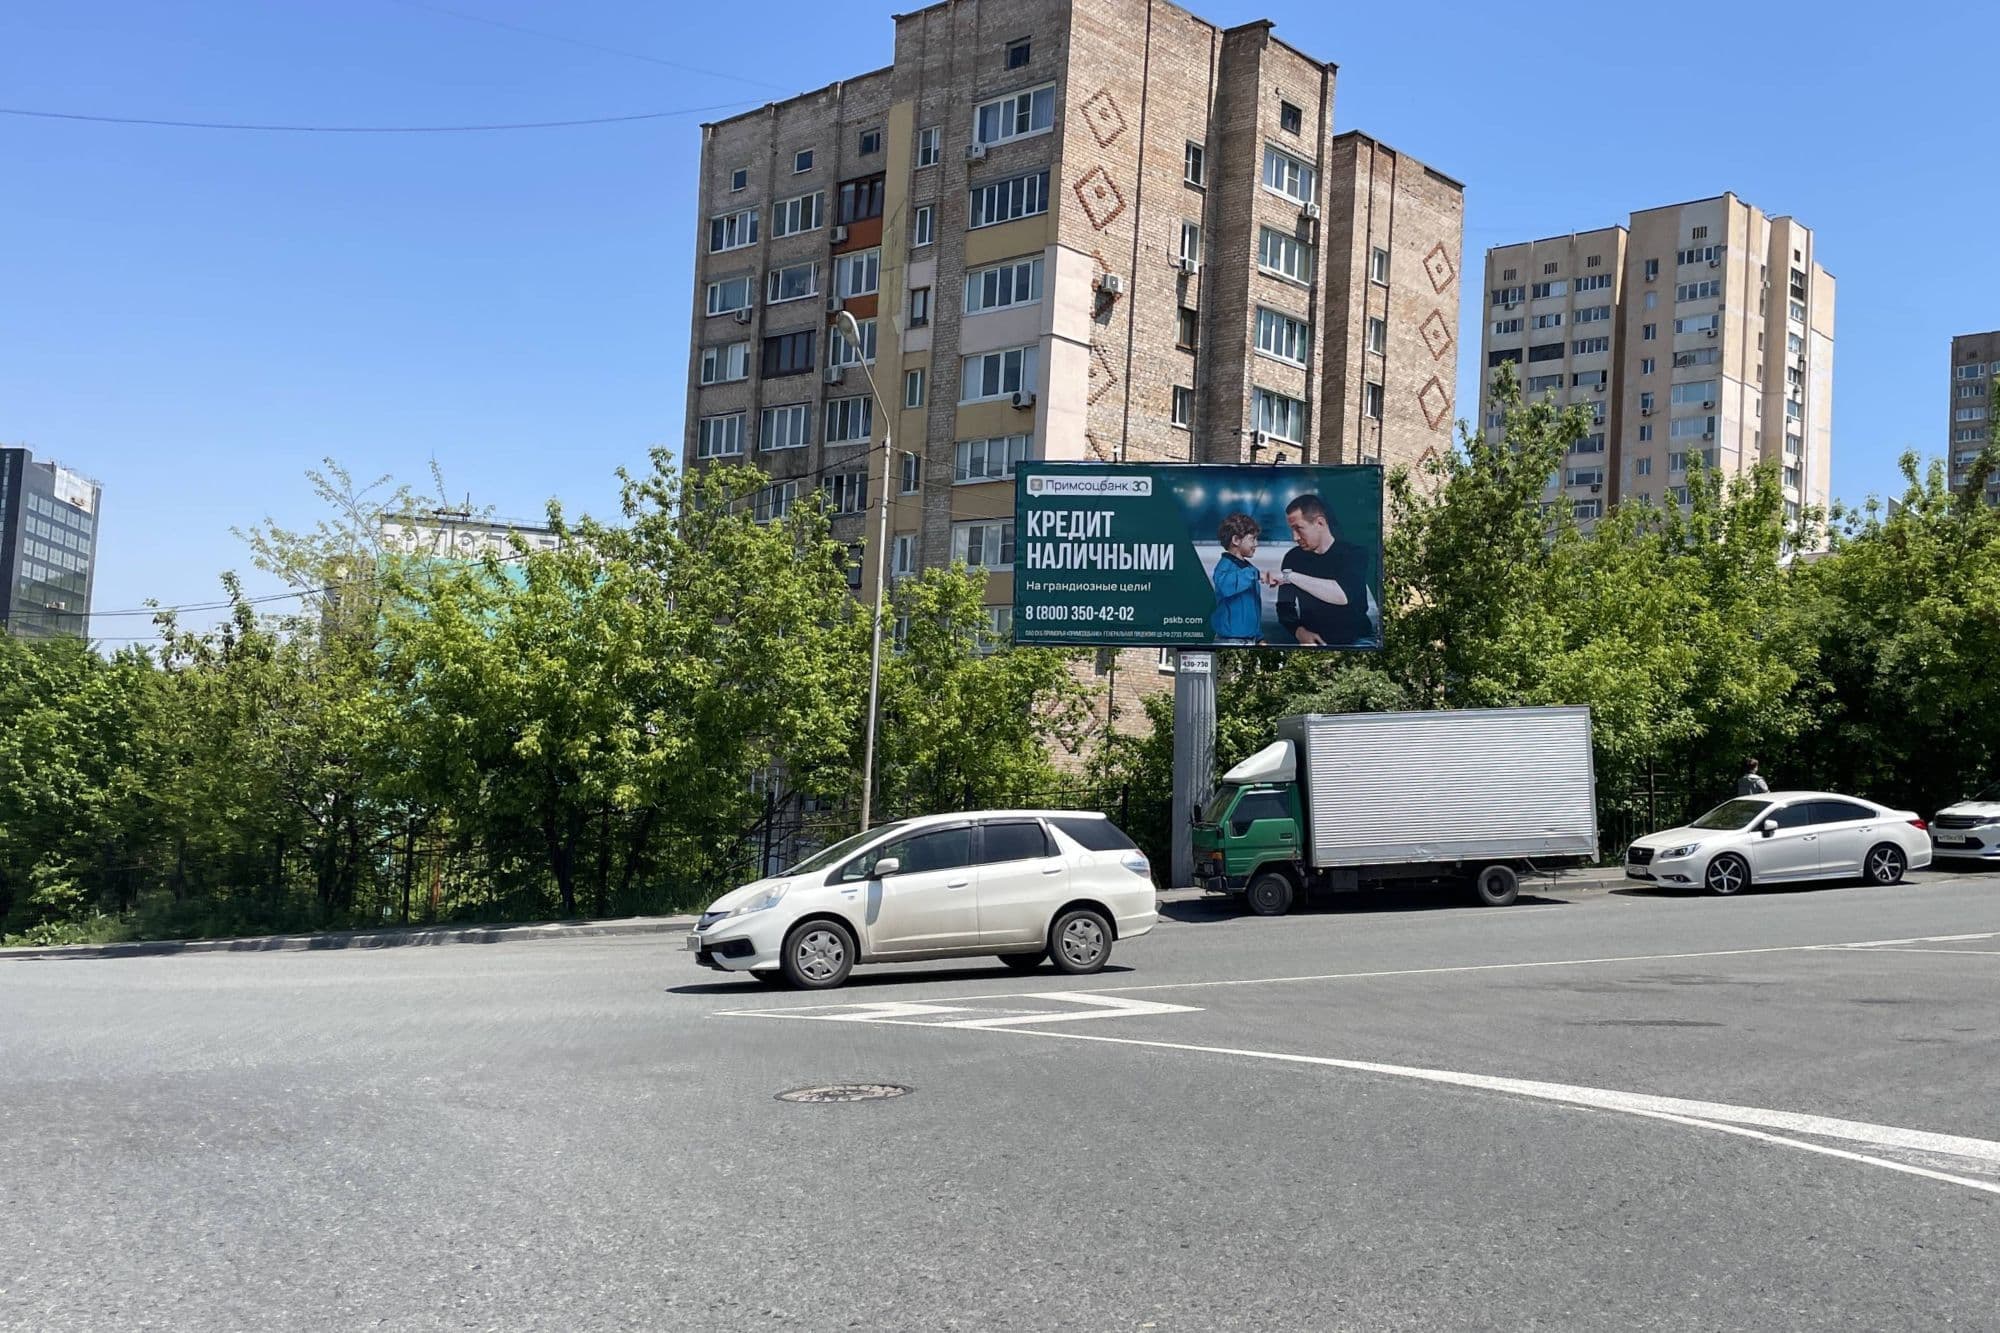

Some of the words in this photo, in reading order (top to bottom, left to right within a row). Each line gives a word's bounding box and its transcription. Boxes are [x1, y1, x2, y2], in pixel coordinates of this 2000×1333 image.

[1045, 479, 1128, 493] Примсоцбанк
[1027, 510, 1115, 540] КРЕДИТ
[1026, 542, 1174, 570] НАЛИЧНЫМИ
[1026, 581, 1041, 591] На
[1043, 582, 1117, 593] грандиозные
[1119, 582, 1151, 592] цели!
[1025, 605, 1033, 620] 8
[1036, 605, 1068, 620] (800)
[1071, 605, 1134, 621] 350-42-02
